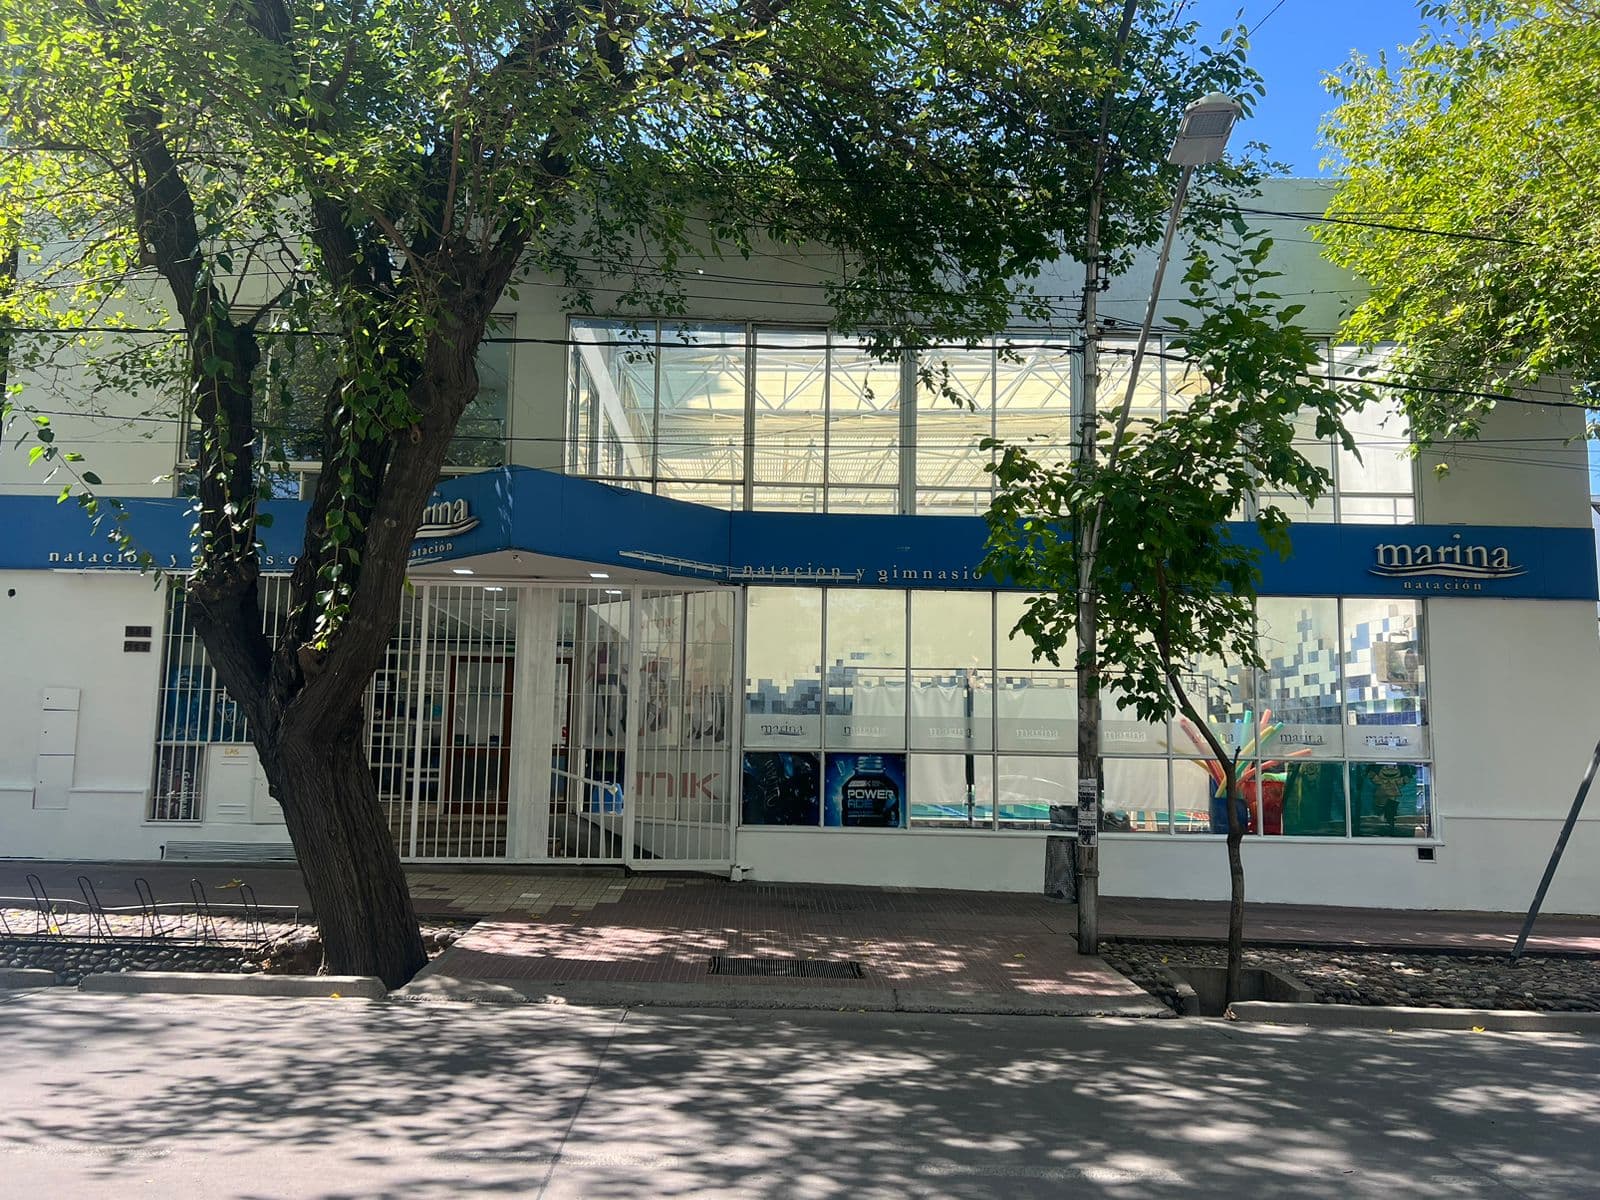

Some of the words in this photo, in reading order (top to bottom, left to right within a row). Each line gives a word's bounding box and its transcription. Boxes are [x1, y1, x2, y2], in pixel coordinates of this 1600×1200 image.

[1375, 533, 1512, 568] marina
[856, 568, 865, 582] y
[877, 564, 983, 583] gimnasio
[847, 789, 895, 800] POWER
